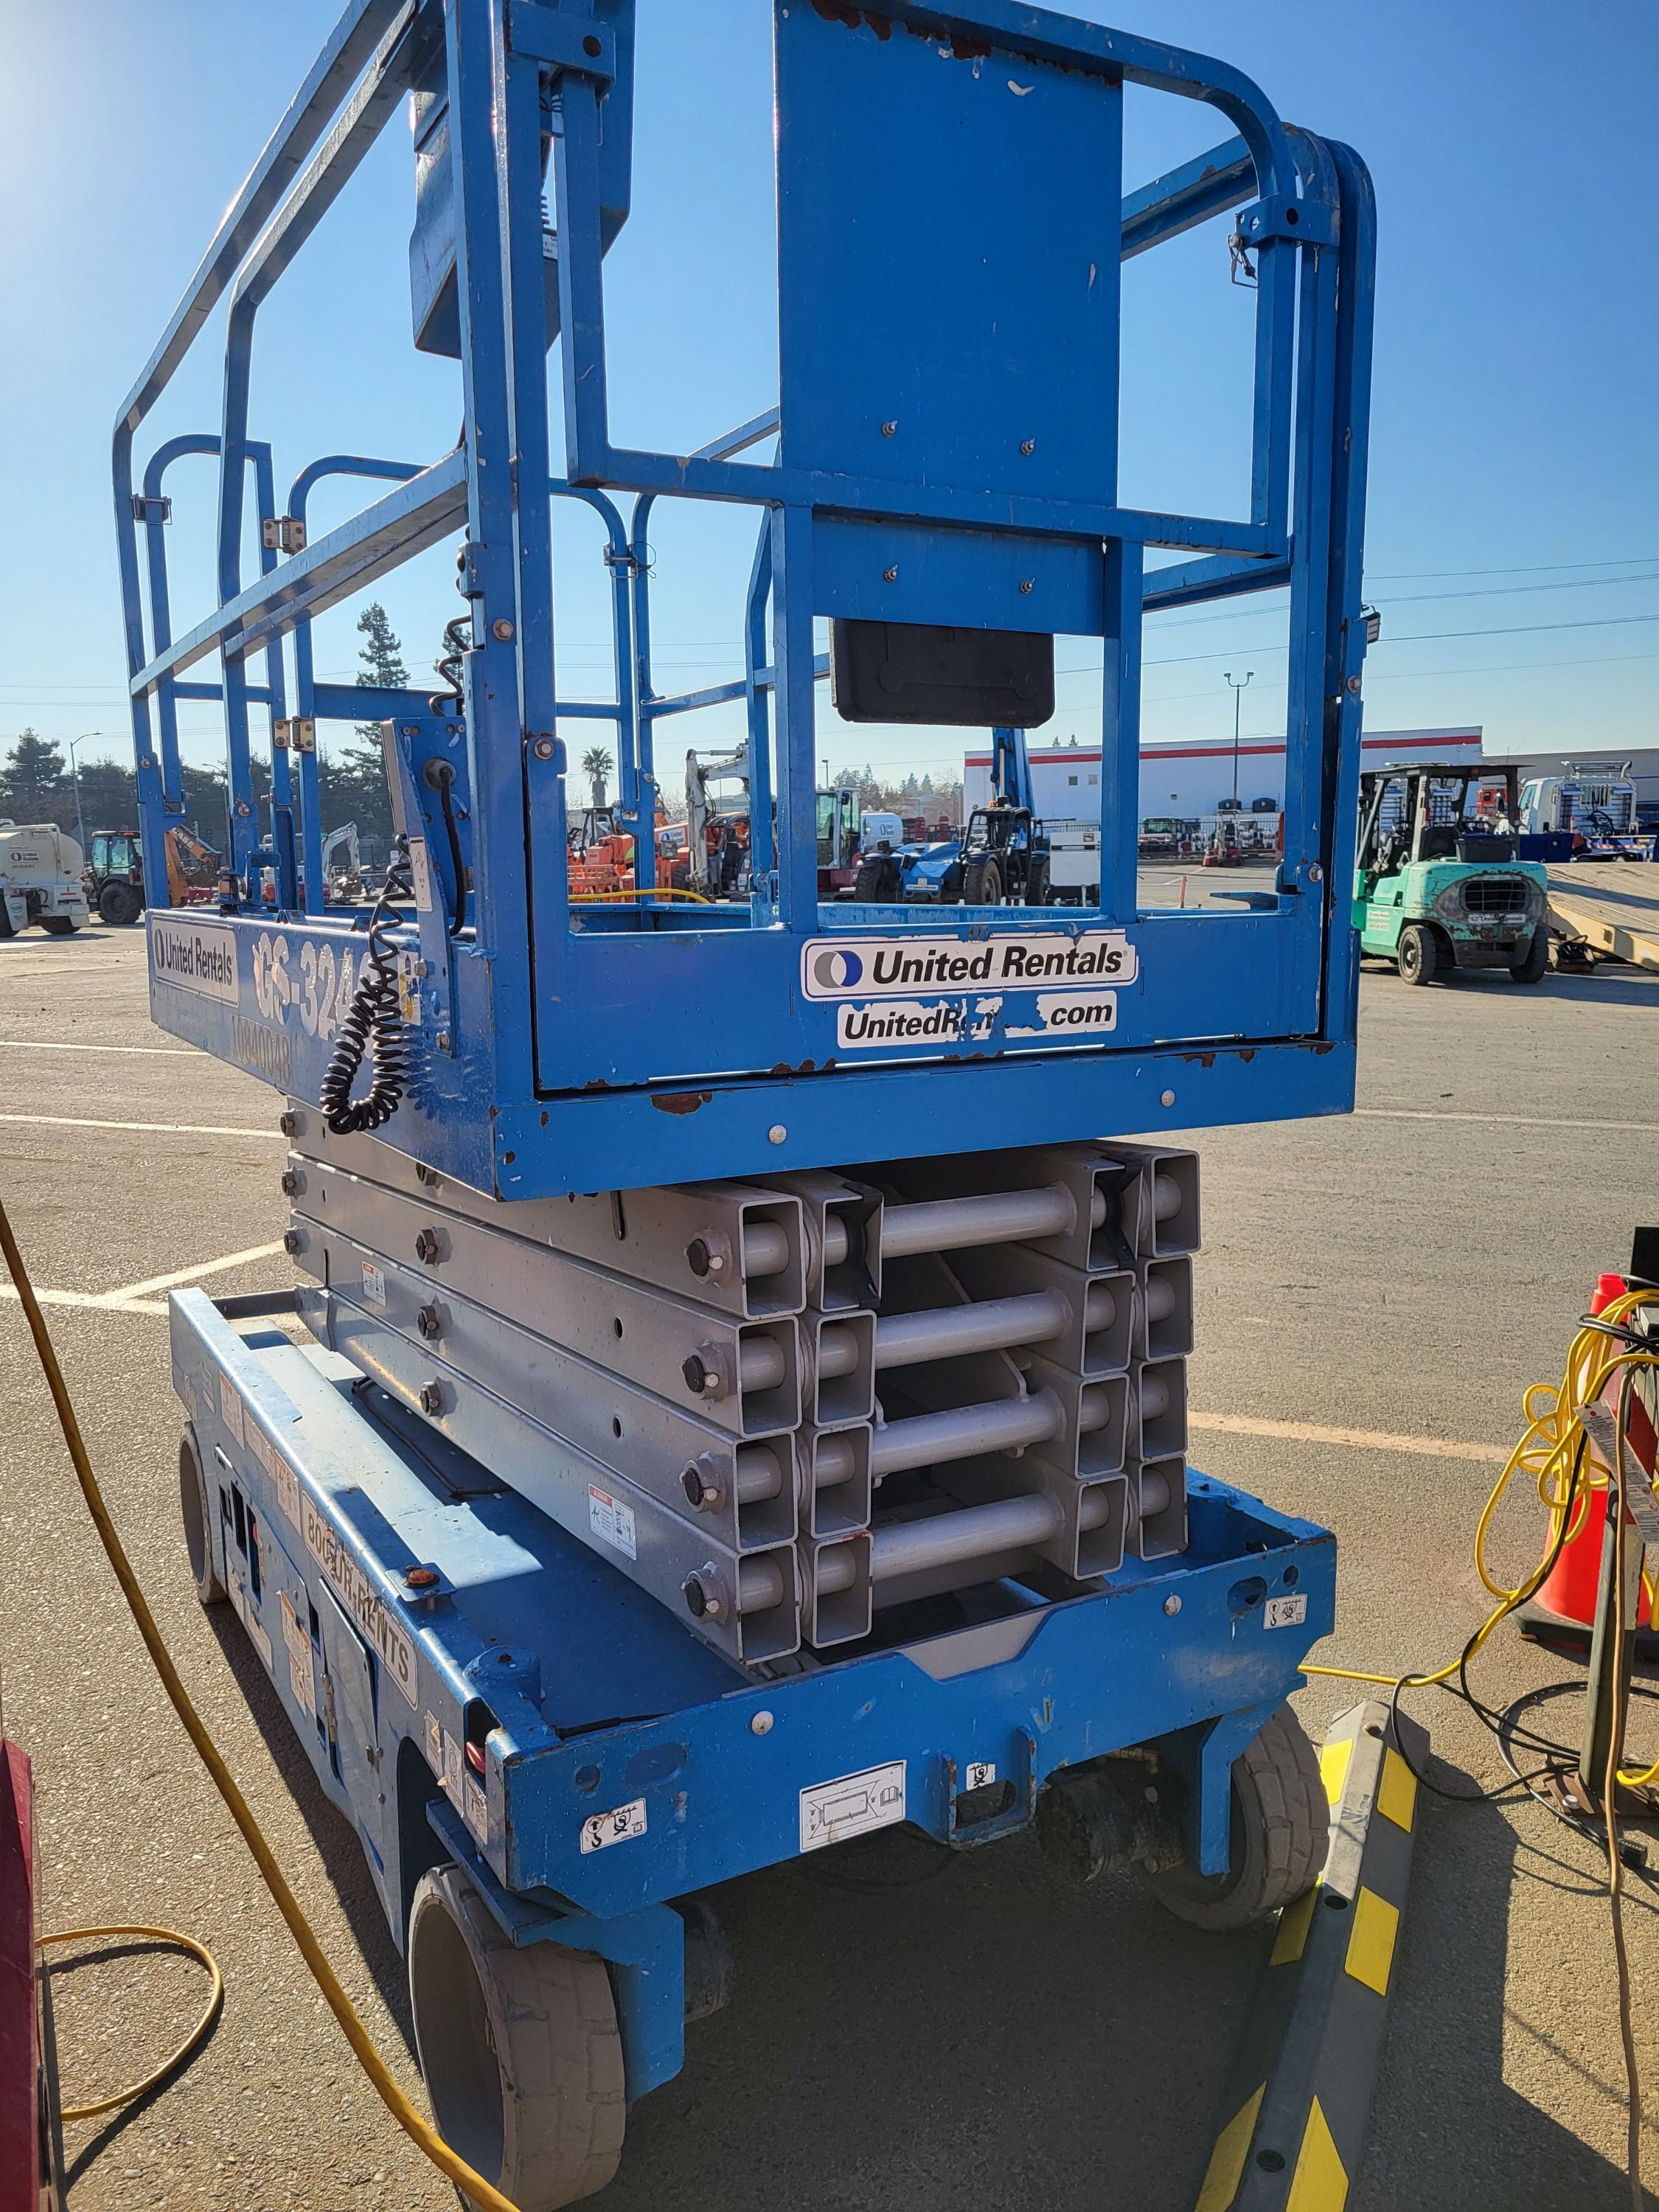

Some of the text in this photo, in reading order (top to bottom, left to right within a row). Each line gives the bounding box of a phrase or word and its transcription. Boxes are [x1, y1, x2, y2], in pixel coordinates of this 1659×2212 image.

[172, 827, 195, 849] CASE
[166, 932, 233, 987] United Rentals
[872, 943, 1123, 984] United Rentals
[232, 1015, 291, 1086] 10840048
